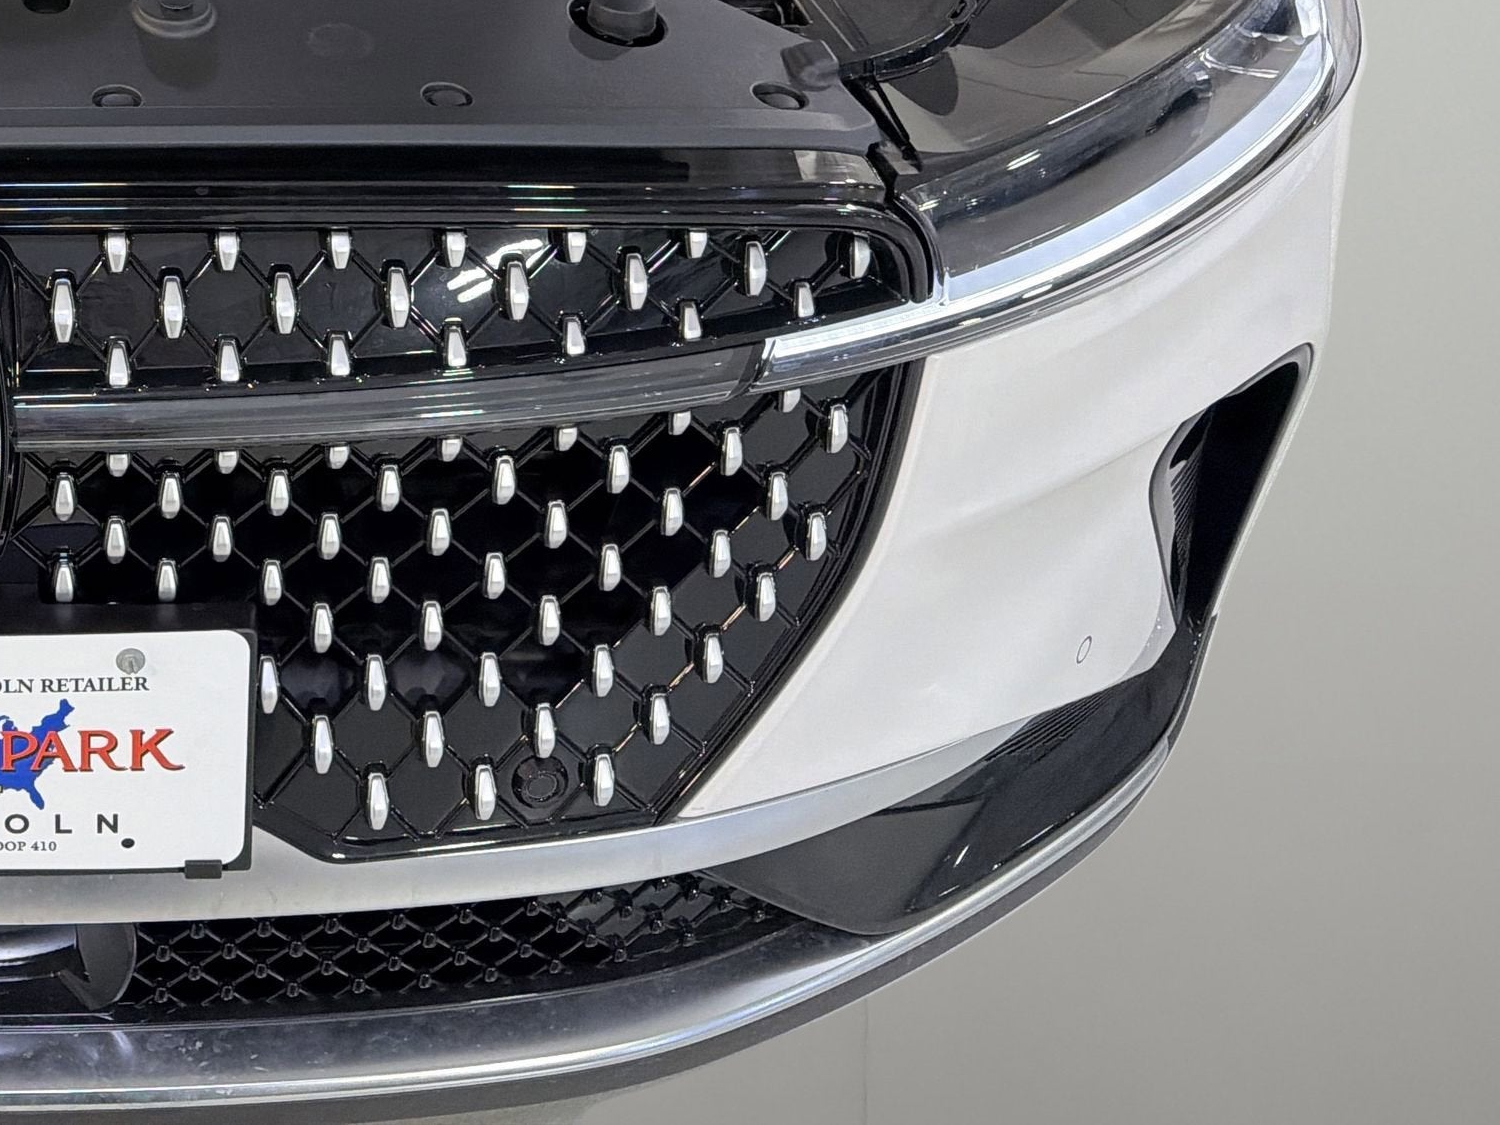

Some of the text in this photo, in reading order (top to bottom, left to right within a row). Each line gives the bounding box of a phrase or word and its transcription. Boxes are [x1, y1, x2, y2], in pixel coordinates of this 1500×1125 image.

[40, 676, 150, 693] RETAILER
[0, 727, 186, 773] PARK
[30, 840, 57, 853] 410
